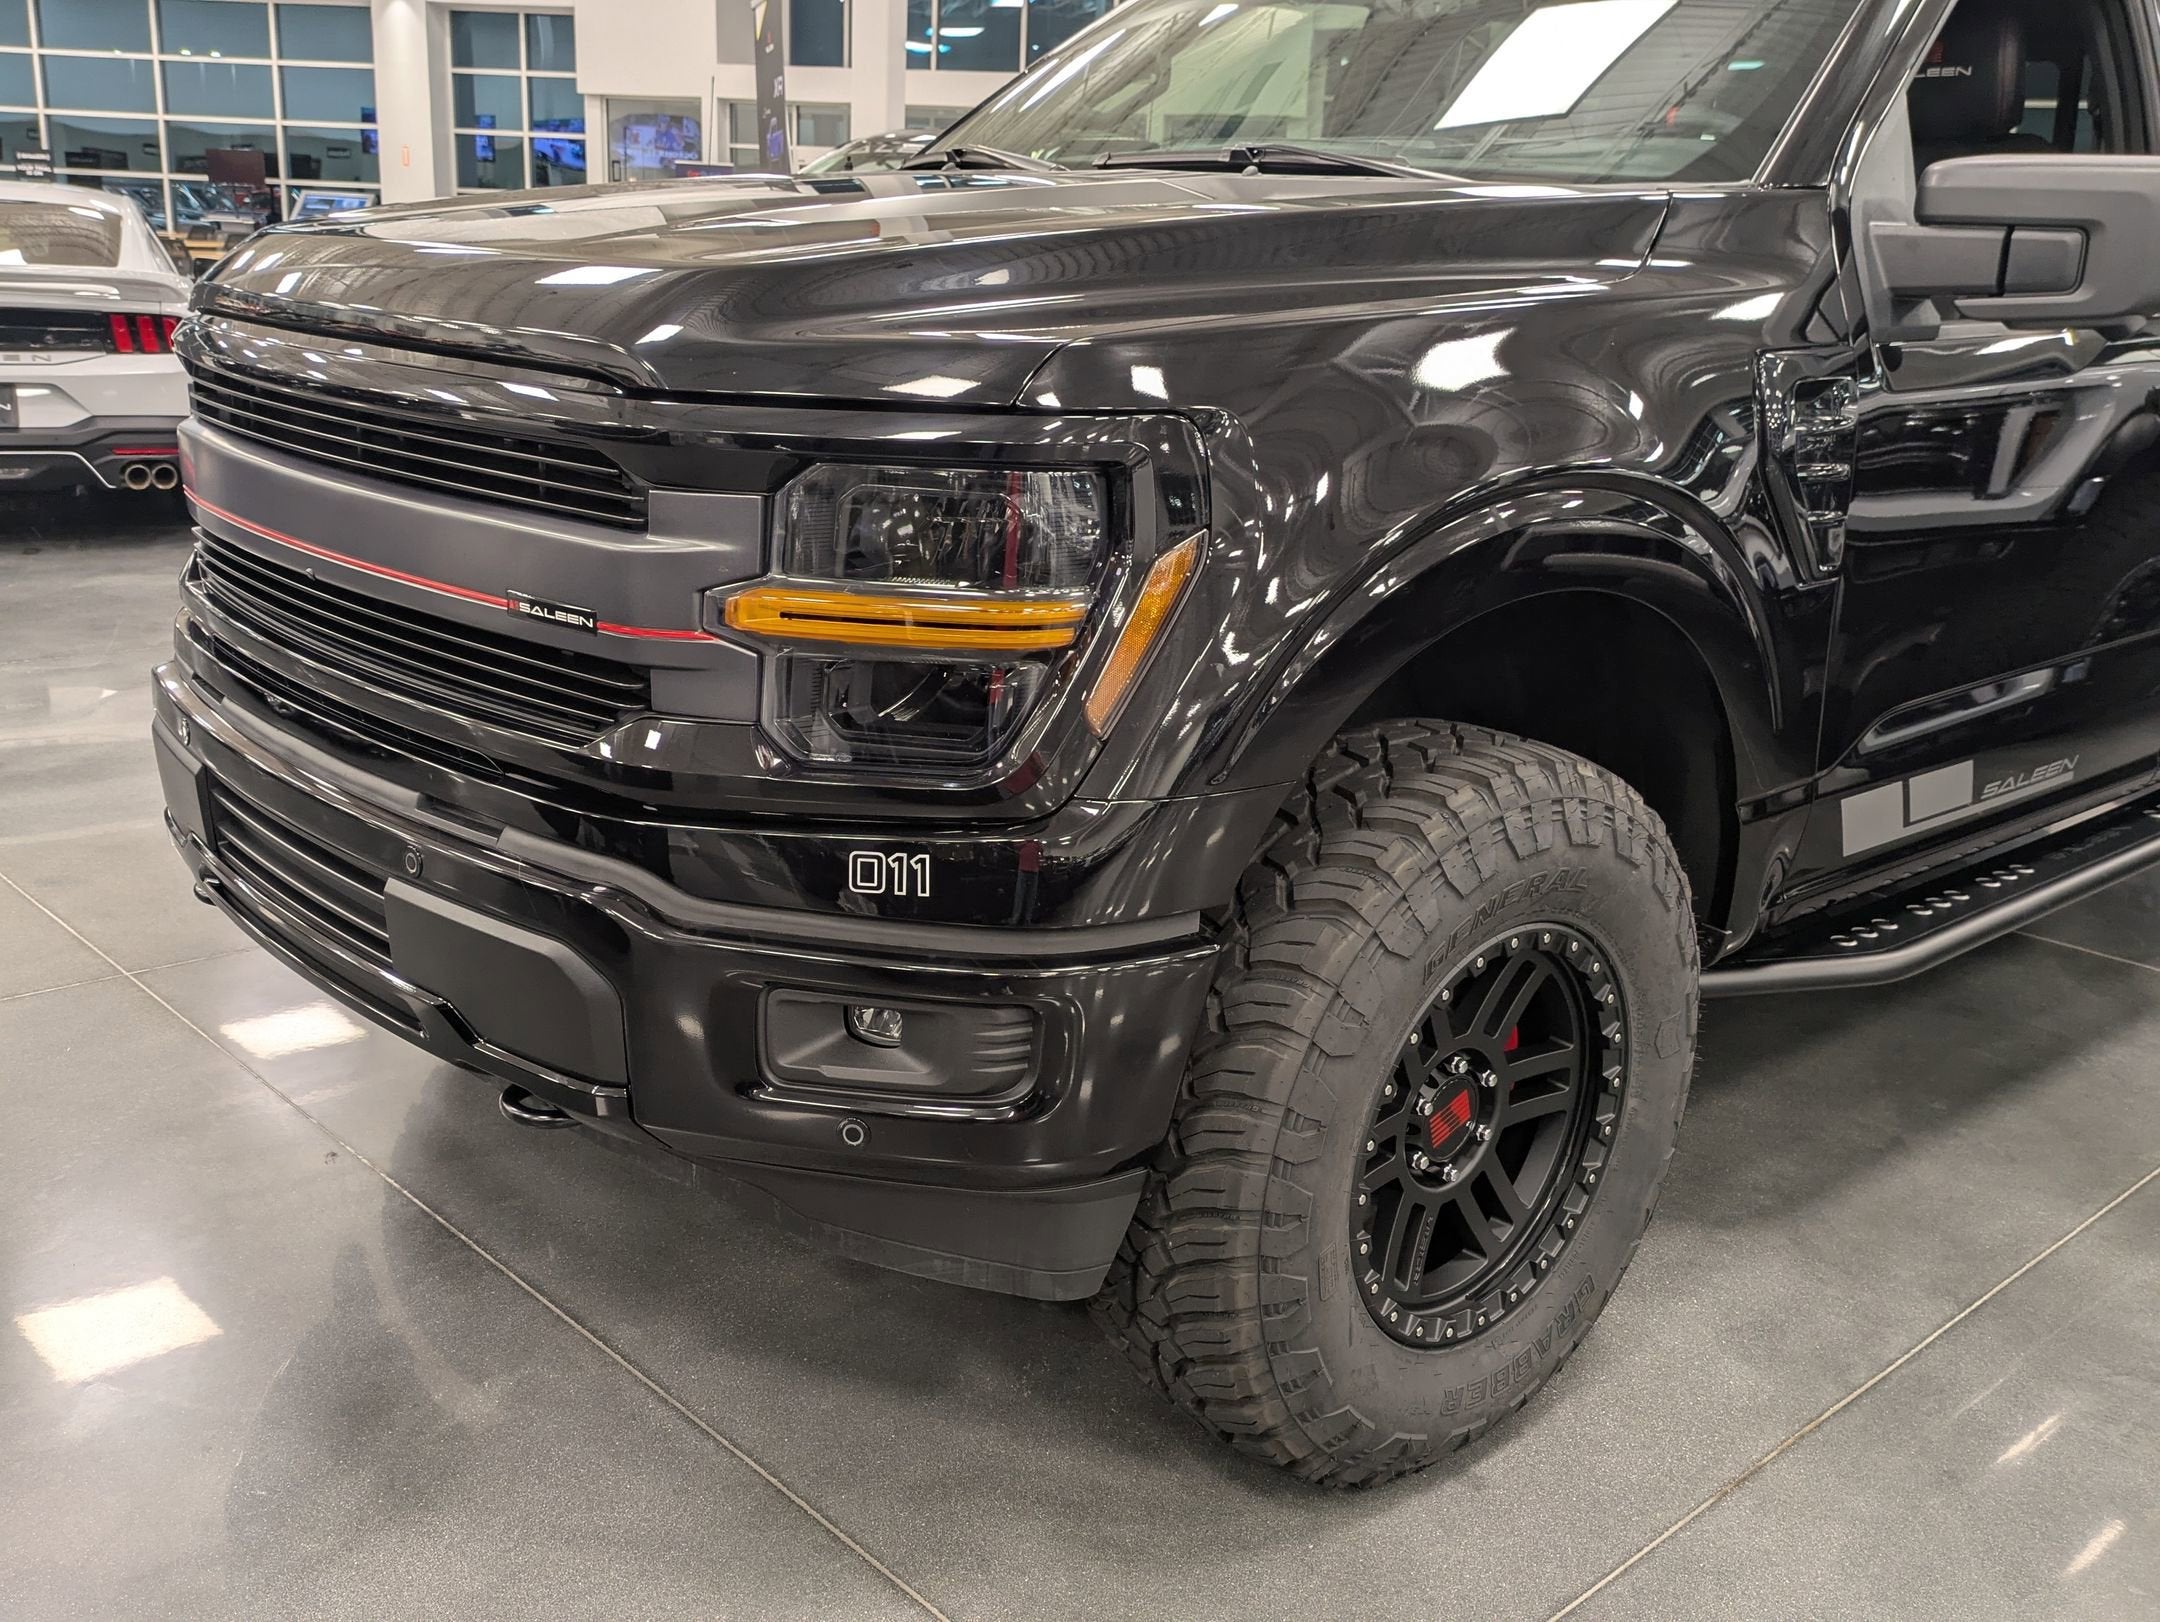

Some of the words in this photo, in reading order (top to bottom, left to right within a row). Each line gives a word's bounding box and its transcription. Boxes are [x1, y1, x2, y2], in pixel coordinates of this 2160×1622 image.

[518, 601, 594, 628] SALEEN
[1980, 754, 2080, 800] SALEEN
[848, 850, 930, 897] 011
[1422, 866, 1589, 986] GENERAL
[1440, 1272, 1597, 1416] GRABBER
